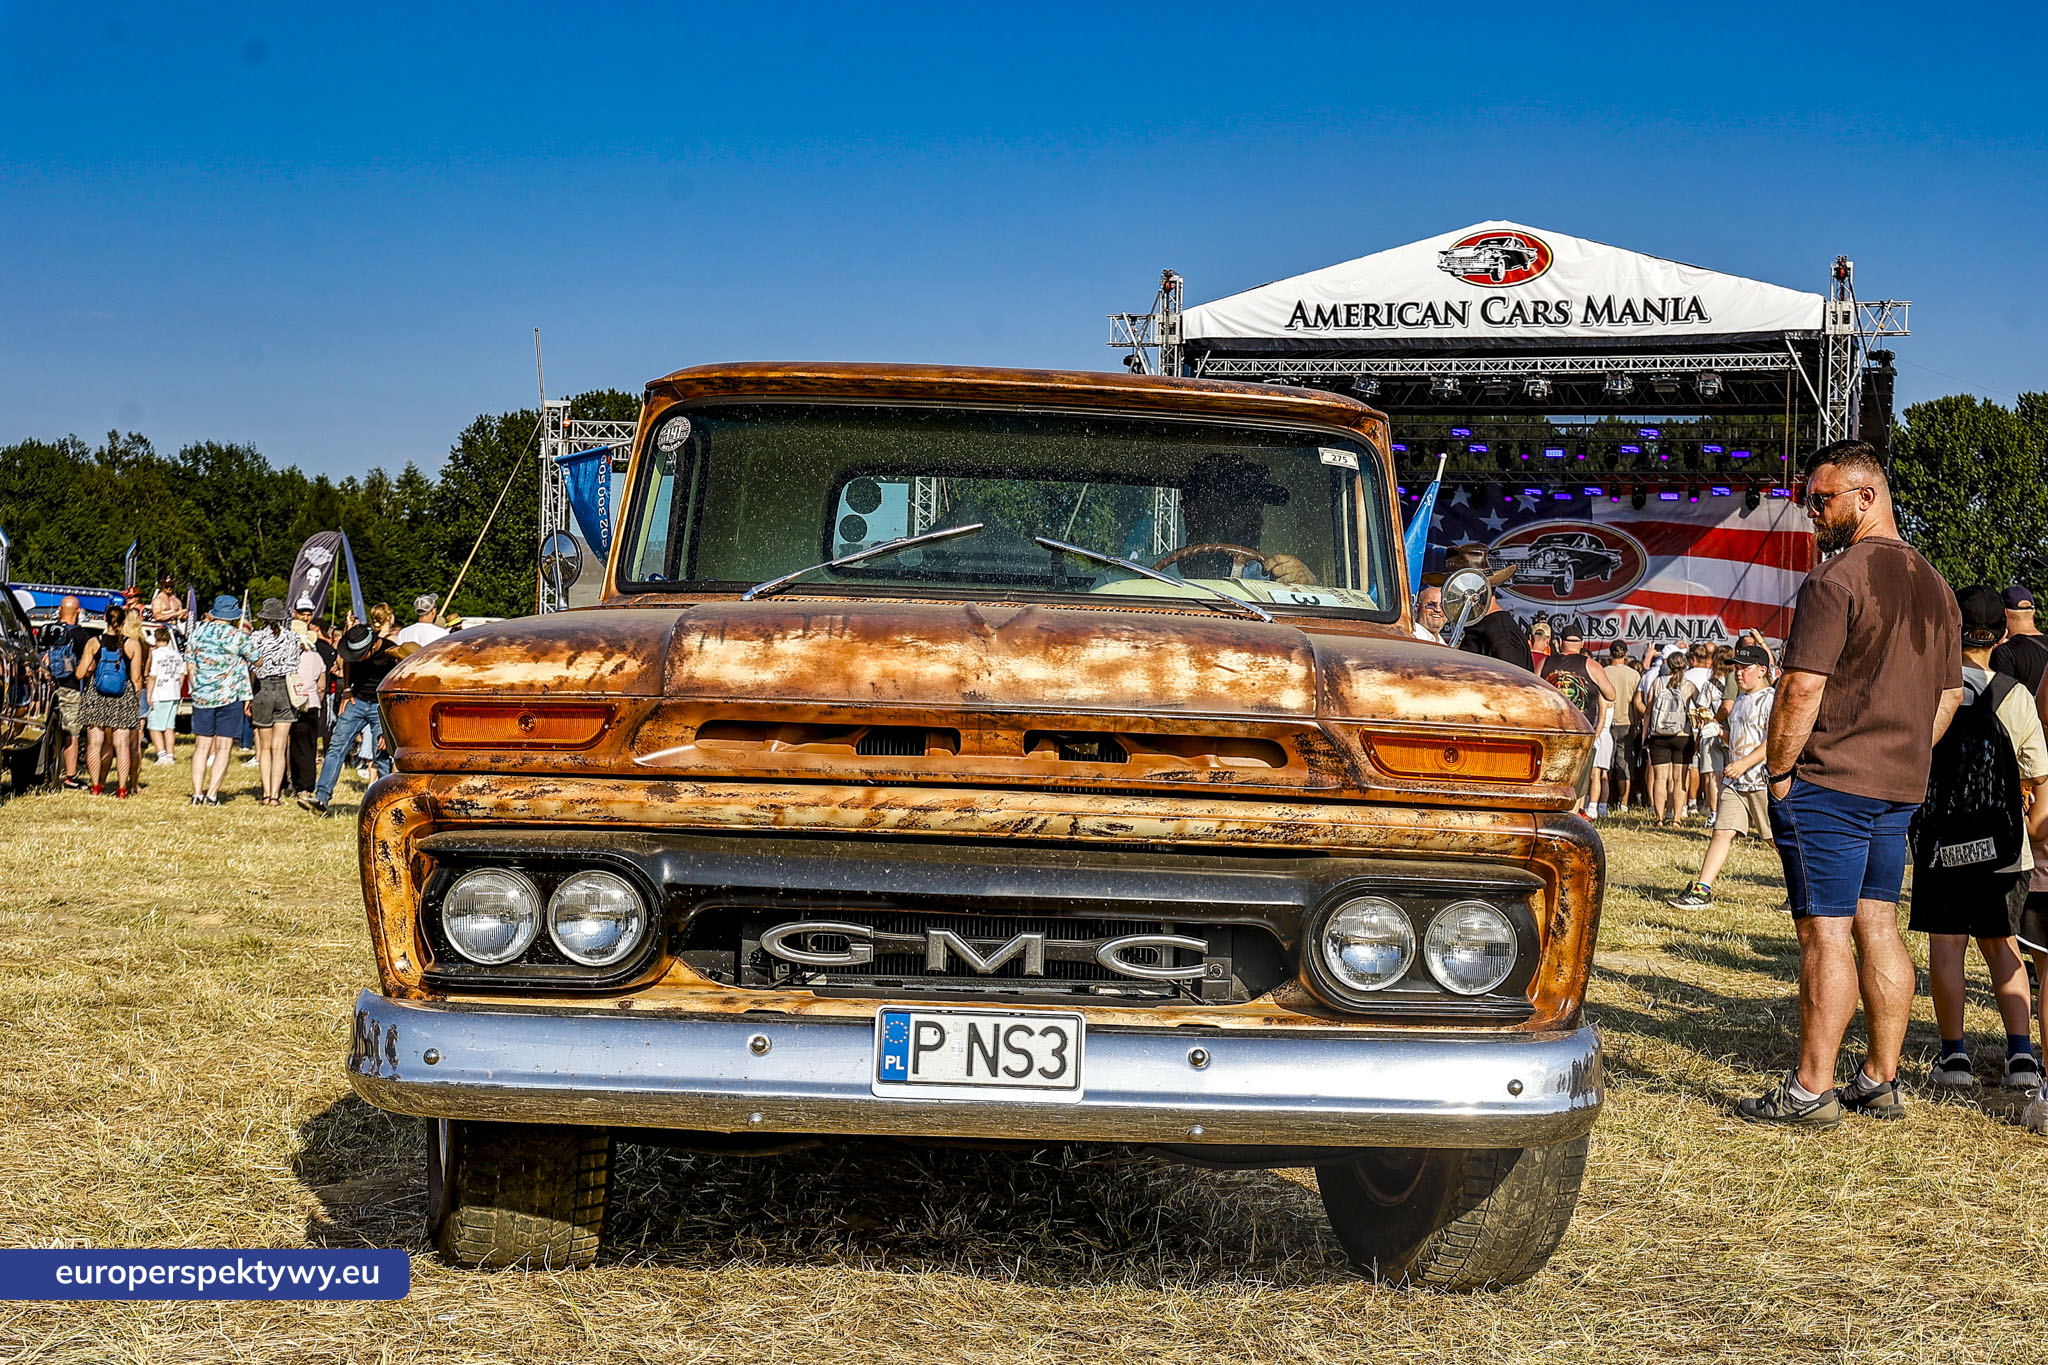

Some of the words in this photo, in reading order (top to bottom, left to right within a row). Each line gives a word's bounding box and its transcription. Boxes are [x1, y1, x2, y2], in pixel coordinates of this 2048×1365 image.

[1285, 299, 1471, 330] AMERICAN
[1480, 296, 1572, 328] CARS
[1580, 294, 1711, 328] MANIA
[1331, 454, 1348, 464] 275
[598, 487, 606, 517] 300
[1625, 614, 1728, 642] MANIA
[1940, 838, 1997, 867] MARVEL
[759, 919, 1209, 980] GMC
[884, 1055, 905, 1071] PL
[913, 1020, 946, 1075] P
[966, 1022, 1069, 1080] NS3
